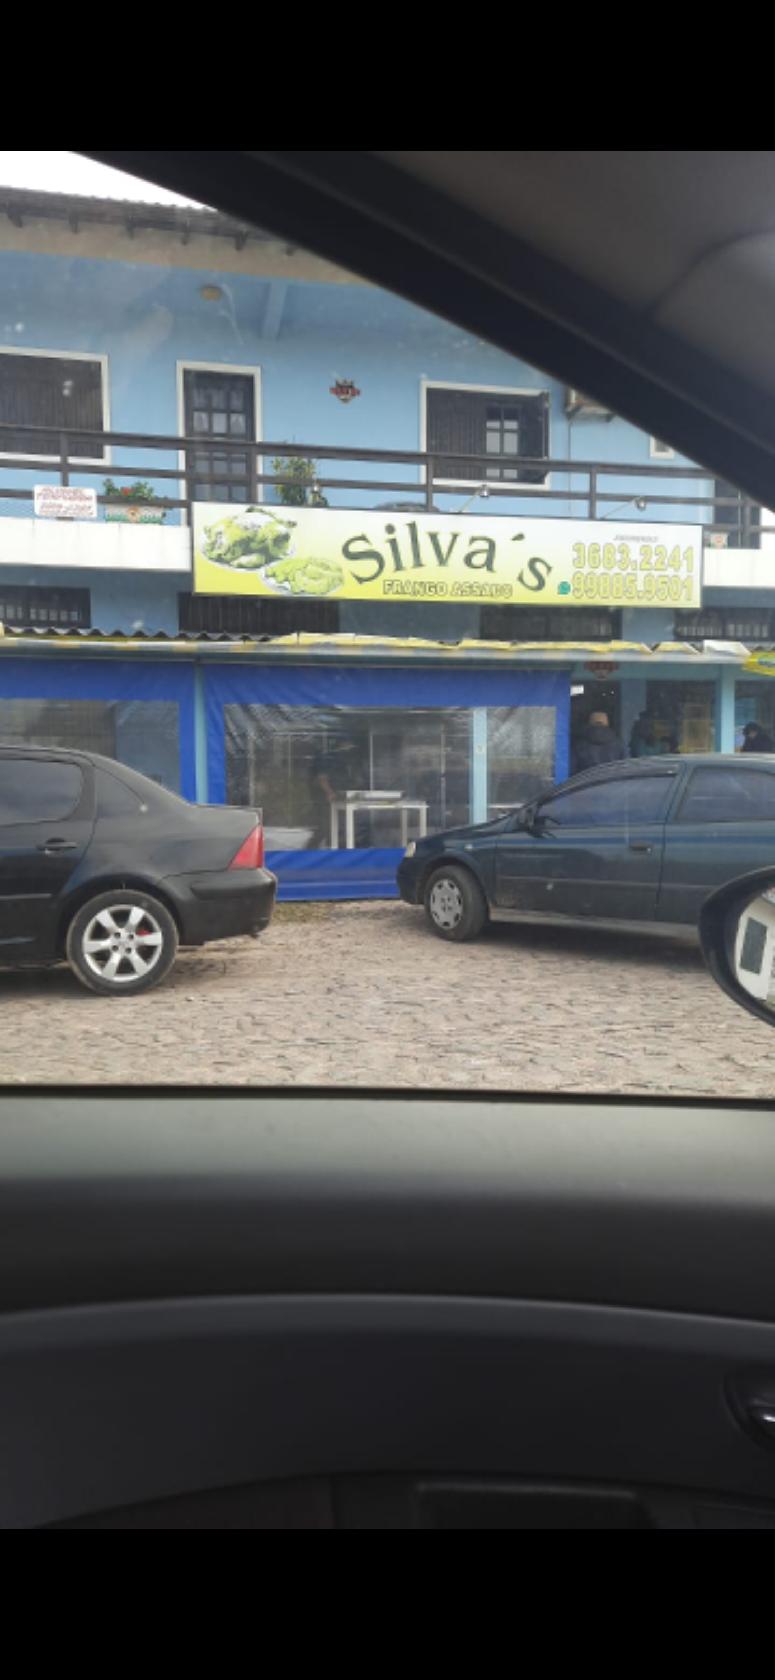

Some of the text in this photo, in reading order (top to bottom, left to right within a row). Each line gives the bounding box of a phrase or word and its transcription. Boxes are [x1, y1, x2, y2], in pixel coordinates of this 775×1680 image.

[571, 542, 694, 573] 3683.2241
[382, 579, 514, 599] FRANGO ASSADO
